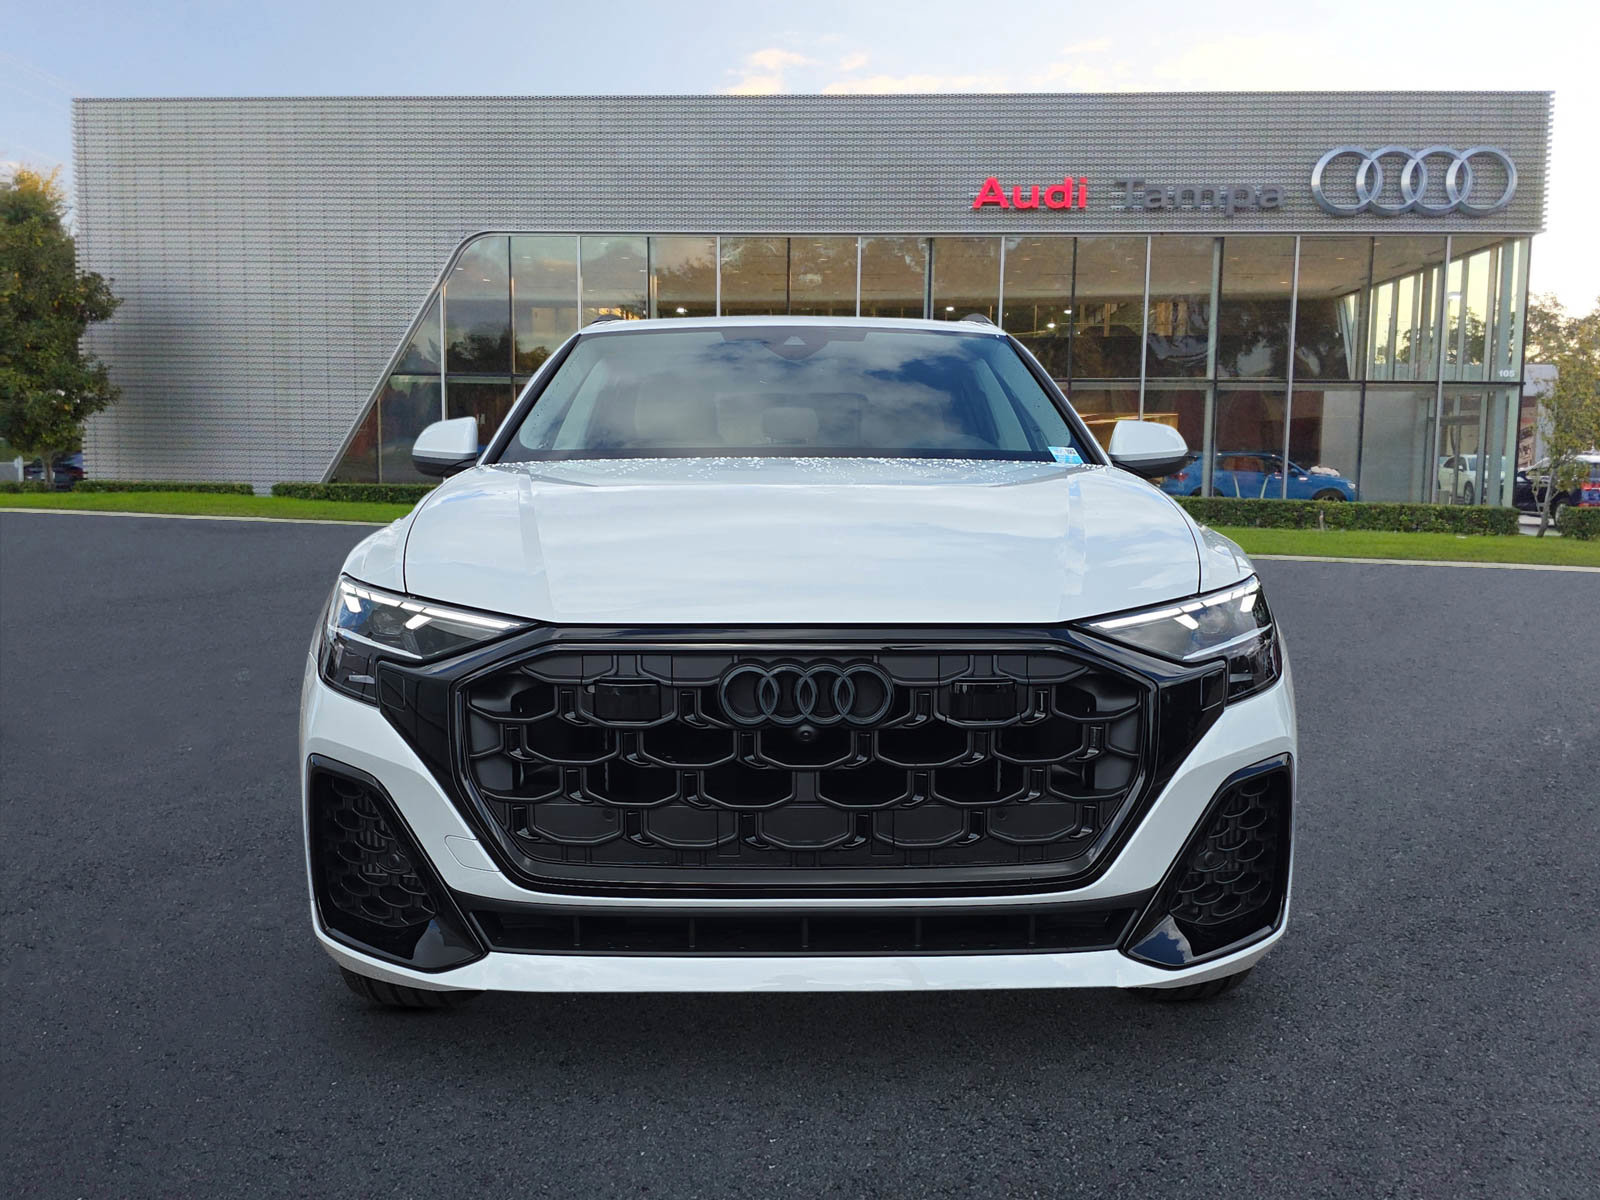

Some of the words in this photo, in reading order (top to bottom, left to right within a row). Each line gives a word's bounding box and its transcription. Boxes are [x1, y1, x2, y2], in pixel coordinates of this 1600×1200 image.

[972, 176, 1088, 209] Audi
[1113, 177, 1285, 217] Tampa
[1499, 369, 1516, 378] 105
